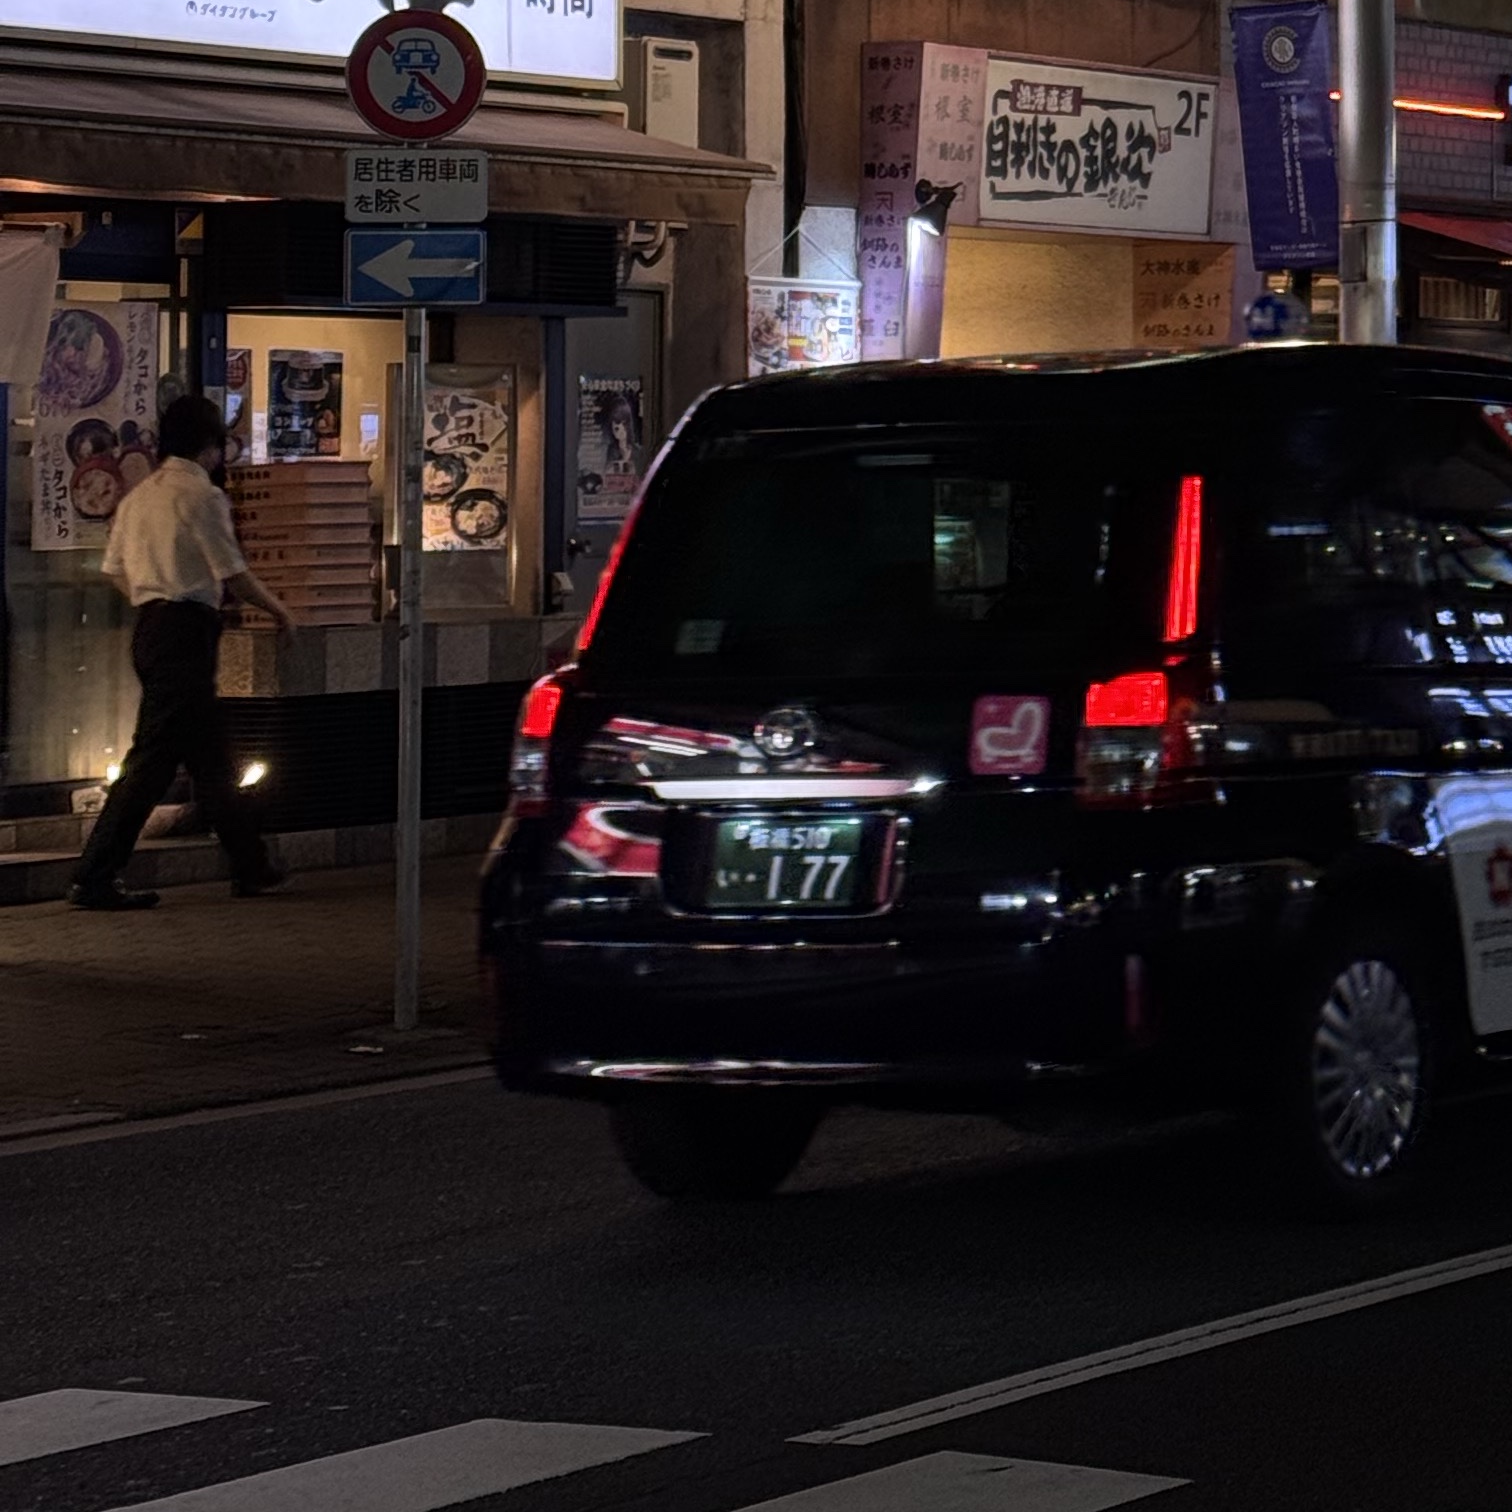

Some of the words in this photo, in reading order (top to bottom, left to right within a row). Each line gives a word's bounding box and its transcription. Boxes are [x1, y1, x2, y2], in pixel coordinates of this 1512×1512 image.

[1174, 90, 1209, 137] 2F
[353, 157, 479, 183] 居住者用車両
[354, 188, 421, 213] を除く
